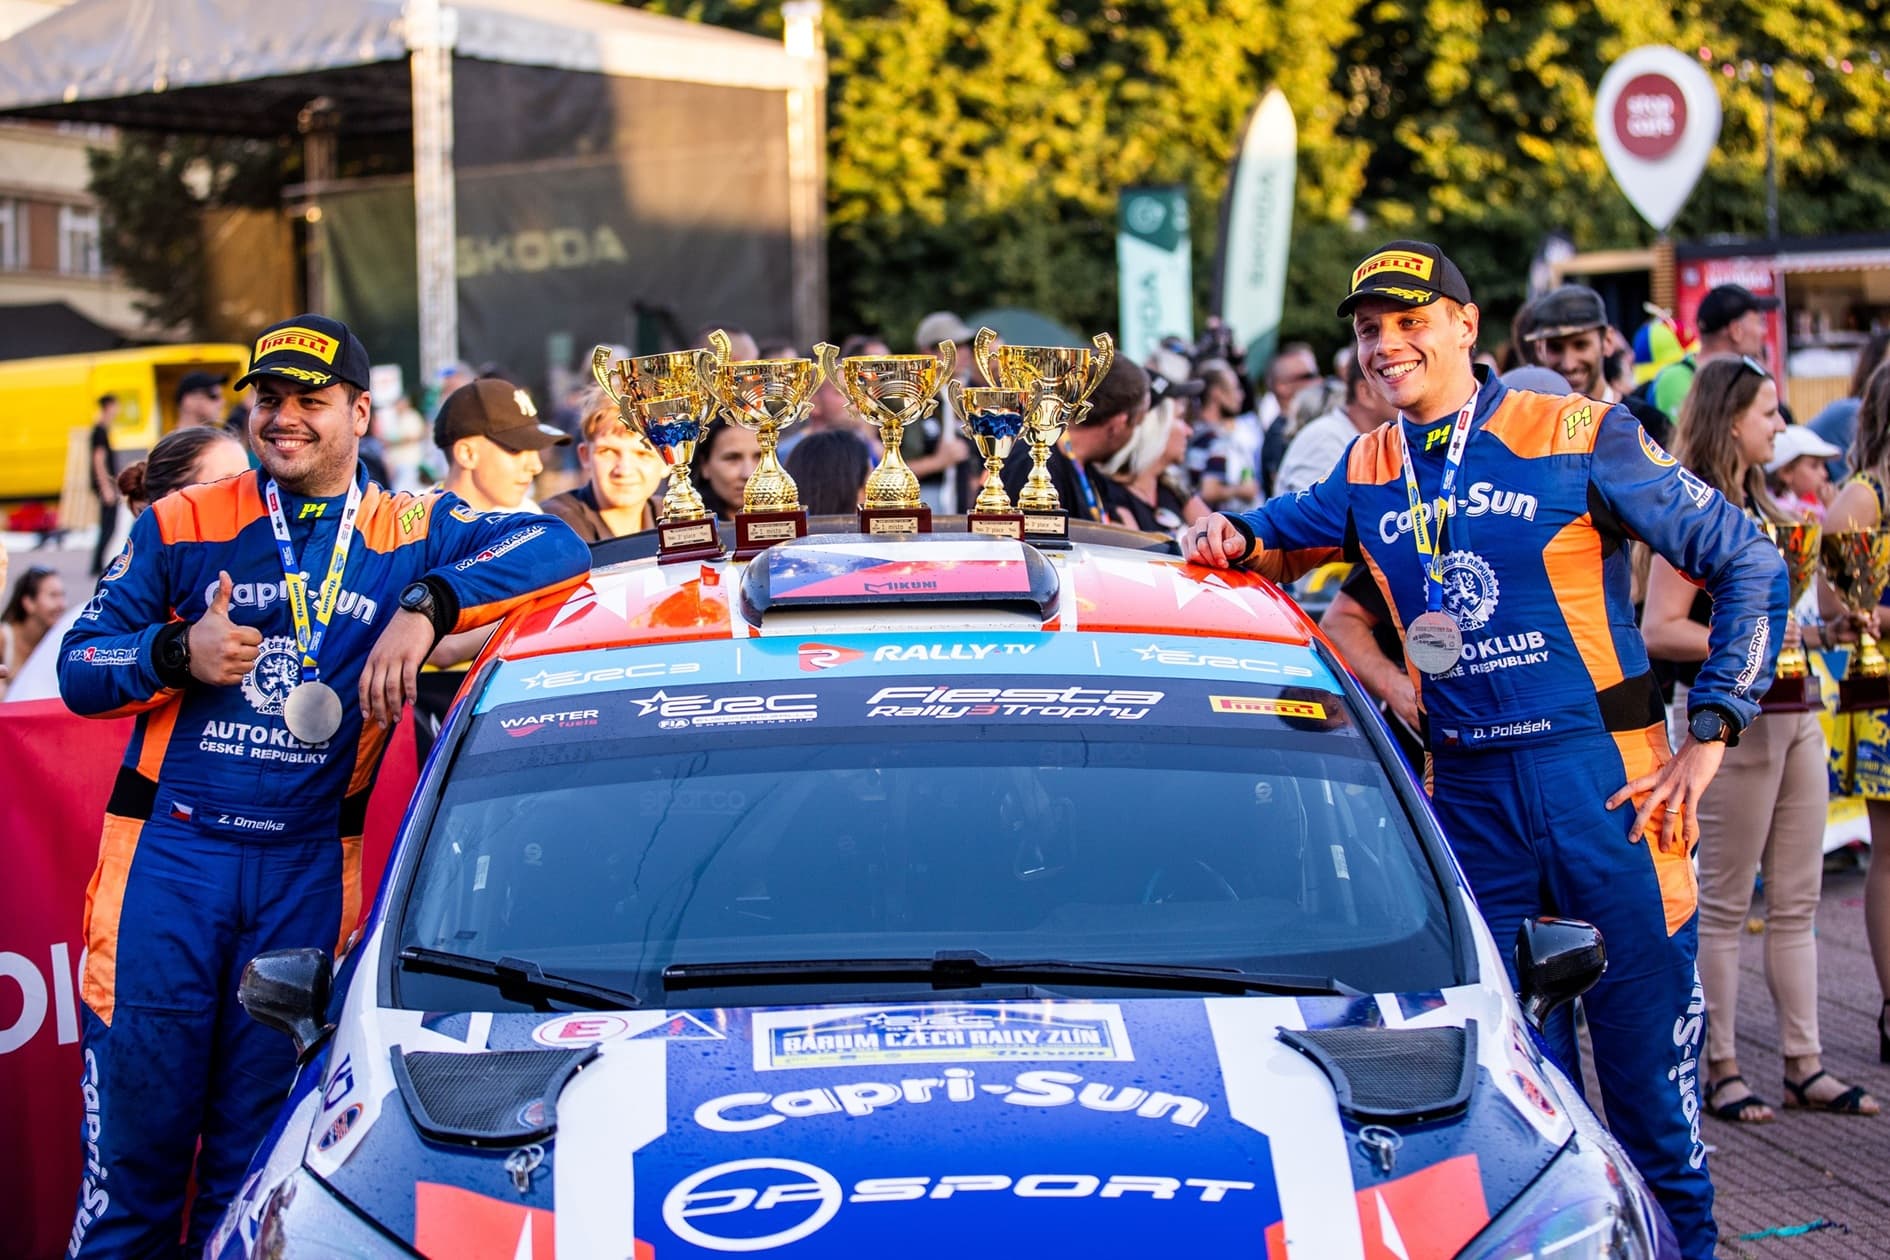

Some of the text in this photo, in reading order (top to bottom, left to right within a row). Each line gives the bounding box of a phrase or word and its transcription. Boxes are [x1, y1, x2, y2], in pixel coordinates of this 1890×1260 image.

[1355, 255, 1423, 281] PIRELLI
[260, 331, 329, 354] PIRELLI
[1379, 482, 1538, 544] Capi-Sun
[864, 580, 937, 593] MIKUNI
[873, 644, 999, 661] RALLY
[1003, 644, 1036, 655] TV
[1461, 631, 1546, 661] OKLUB
[1470, 650, 1549, 676] REPUBLIKY
[659, 694, 818, 718] ERC
[866, 686, 1165, 704] Fiesta
[1002, 704, 1150, 720] Trophy
[1220, 699, 1315, 715] PIRELLI
[500, 709, 599, 729] WARTER
[1473, 718, 1551, 739] D. Polášek
[202, 720, 329, 750] AUTOKL
[200, 738, 328, 764] ČESKÉ REPUBLIKY
[218, 814, 285, 831] Z. Omelka
[558, 1020, 609, 1039] E
[783, 1033, 879, 1053] BARUM
[885, 1030, 965, 1048] CZECH
[969, 1028, 1040, 1045] RALLY
[694, 1068, 1208, 1132] Capri-Sun
[850, 1174, 1255, 1203] SPORT
